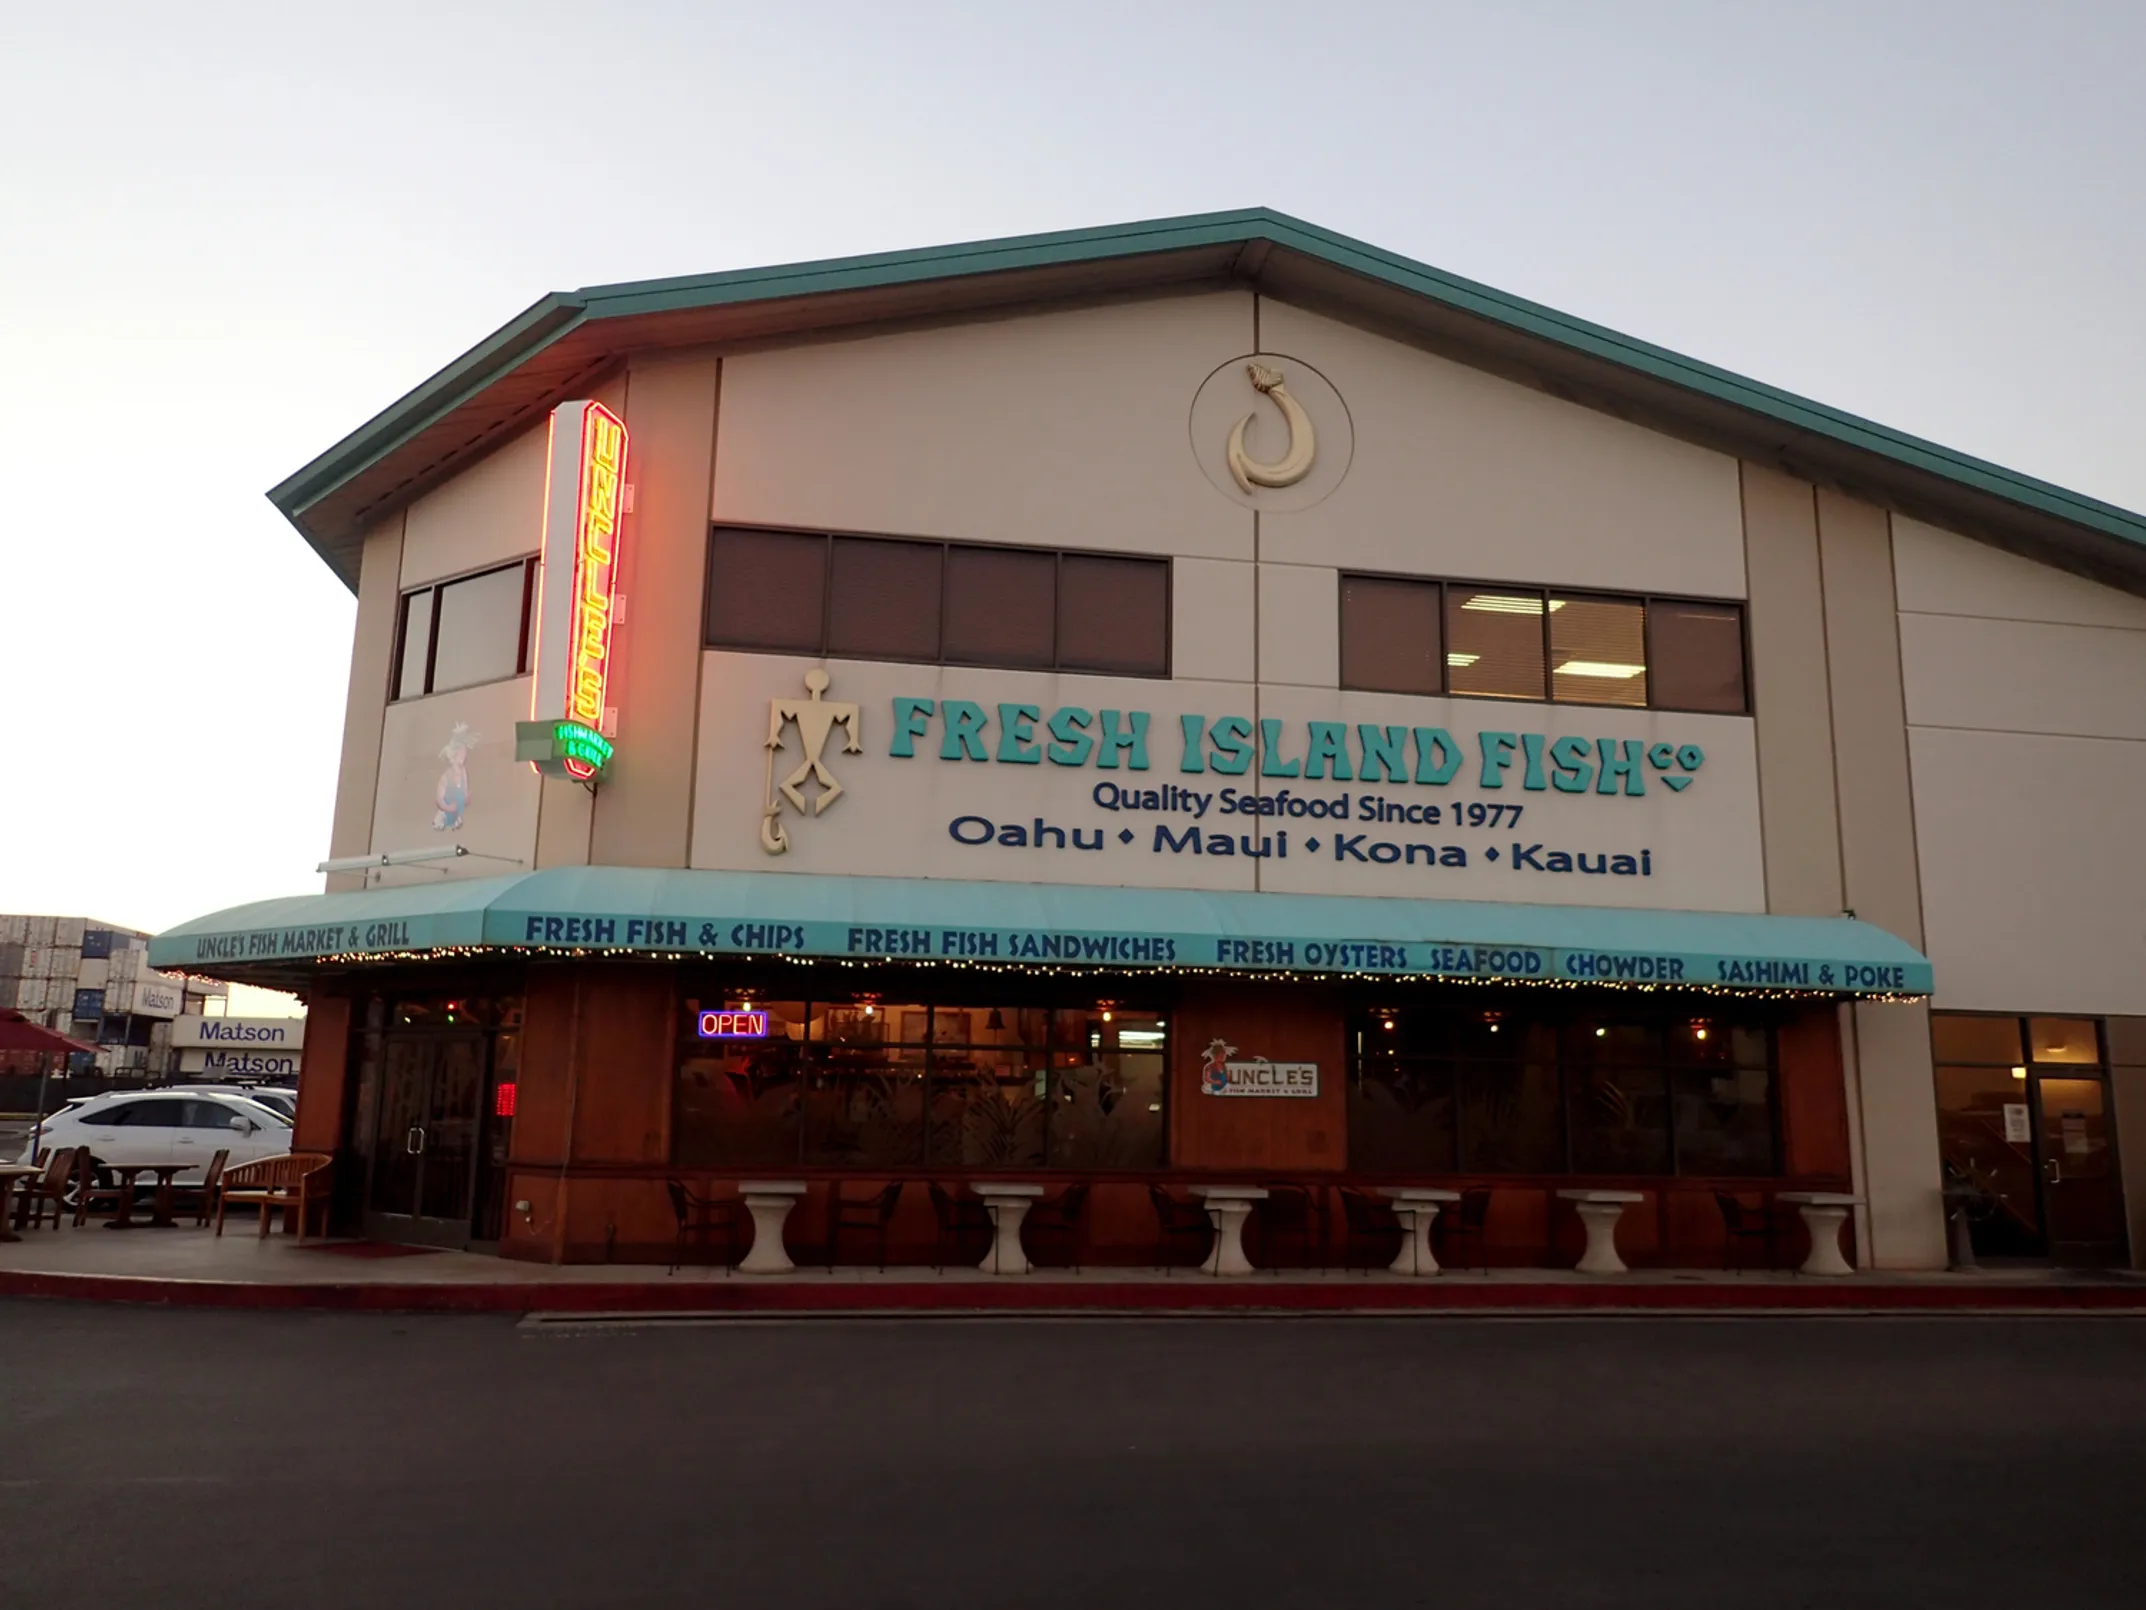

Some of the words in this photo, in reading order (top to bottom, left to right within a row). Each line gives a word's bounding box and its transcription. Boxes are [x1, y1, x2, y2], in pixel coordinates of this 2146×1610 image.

[576, 415, 621, 720] UNCLE'S
[889, 697, 1150, 770] FRESH
[1180, 714, 1464, 788] ISLAND
[1479, 731, 1645, 796] FISH
[1093, 782, 1212, 819] Quality
[1219, 788, 1350, 820] Seafood
[1358, 795, 1441, 825] Since
[1450, 802, 1524, 828] 1977
[949, 815, 1104, 850] Oahu
[1153, 825, 1288, 858] Maui
[1335, 833, 1468, 867] Kona
[1512, 842, 1652, 876] Kauai
[196, 933, 245, 958] UNCLE'S
[249, 932, 279, 954] FISH
[281, 926, 344, 953] MARKET
[348, 926, 359, 948] &
[366, 921, 410, 947] GRILL
[525, 916, 615, 943] FRESH
[626, 919, 687, 945] FISH
[698, 922, 719, 947] &
[731, 923, 804, 949] CHIPS
[848, 928, 931, 954] FRESH
[942, 931, 998, 956] FISH
[1008, 934, 1176, 961] SANDWICHES
[1217, 939, 1294, 966] FRESH
[1304, 943, 1407, 969] OYSTERS
[1431, 947, 1541, 974] SEAFOOD
[1566, 953, 1684, 980] CHOWDER
[1717, 959, 1809, 985] SASHIMI
[1818, 963, 1835, 986] &
[1845, 964, 1904, 988] POKE
[142, 984, 175, 1011] Matson
[200, 1020, 285, 1042] Matson
[702, 1014, 763, 1035] OPEN
[205, 1051, 294, 1075] Matson
[1229, 1064, 1313, 1086] UNCLE'S
